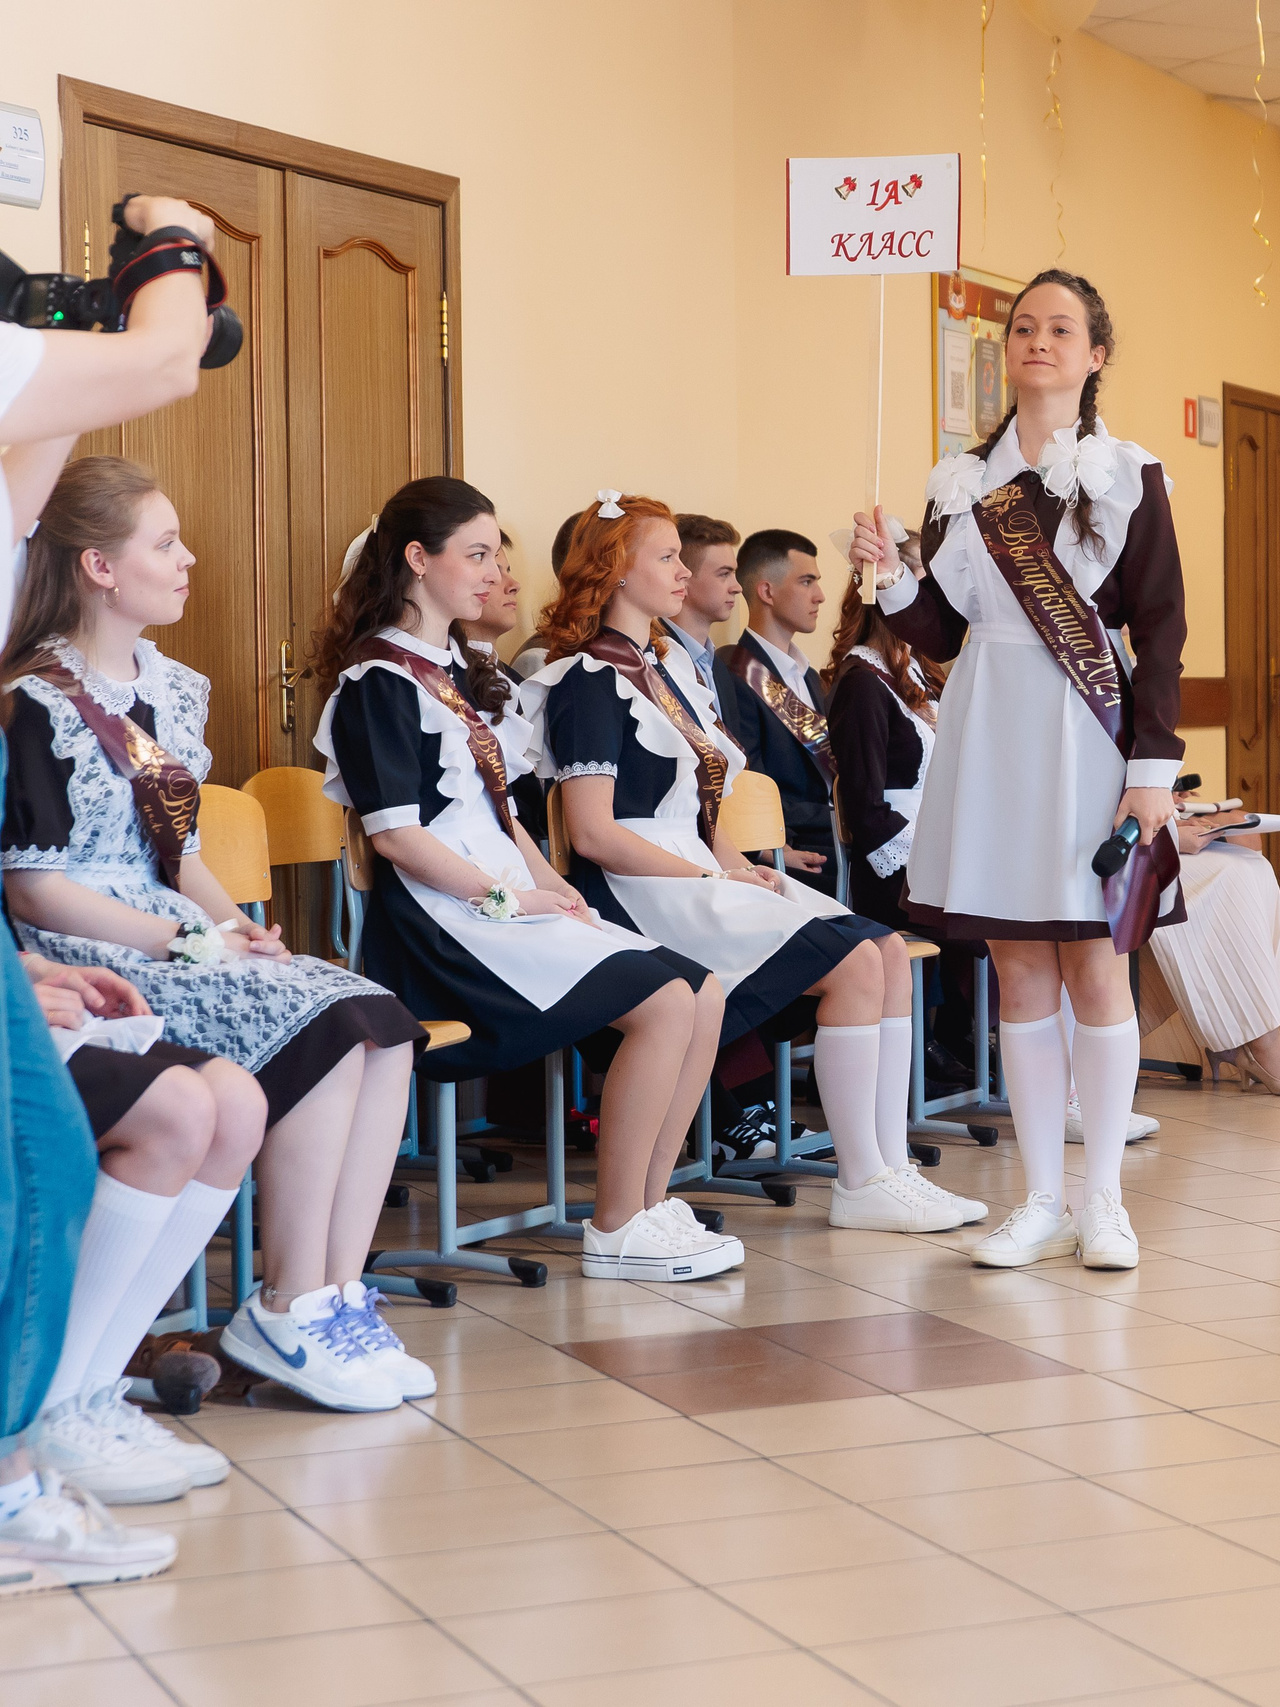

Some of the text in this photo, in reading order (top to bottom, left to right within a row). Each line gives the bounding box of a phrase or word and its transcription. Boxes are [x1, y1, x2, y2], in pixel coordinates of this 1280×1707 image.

[12, 126, 29, 141] 325
[866, 179, 902, 211] 1А
[830, 230, 934, 262] КЛАСС
[997, 510, 1122, 708] Выпускница 2024
